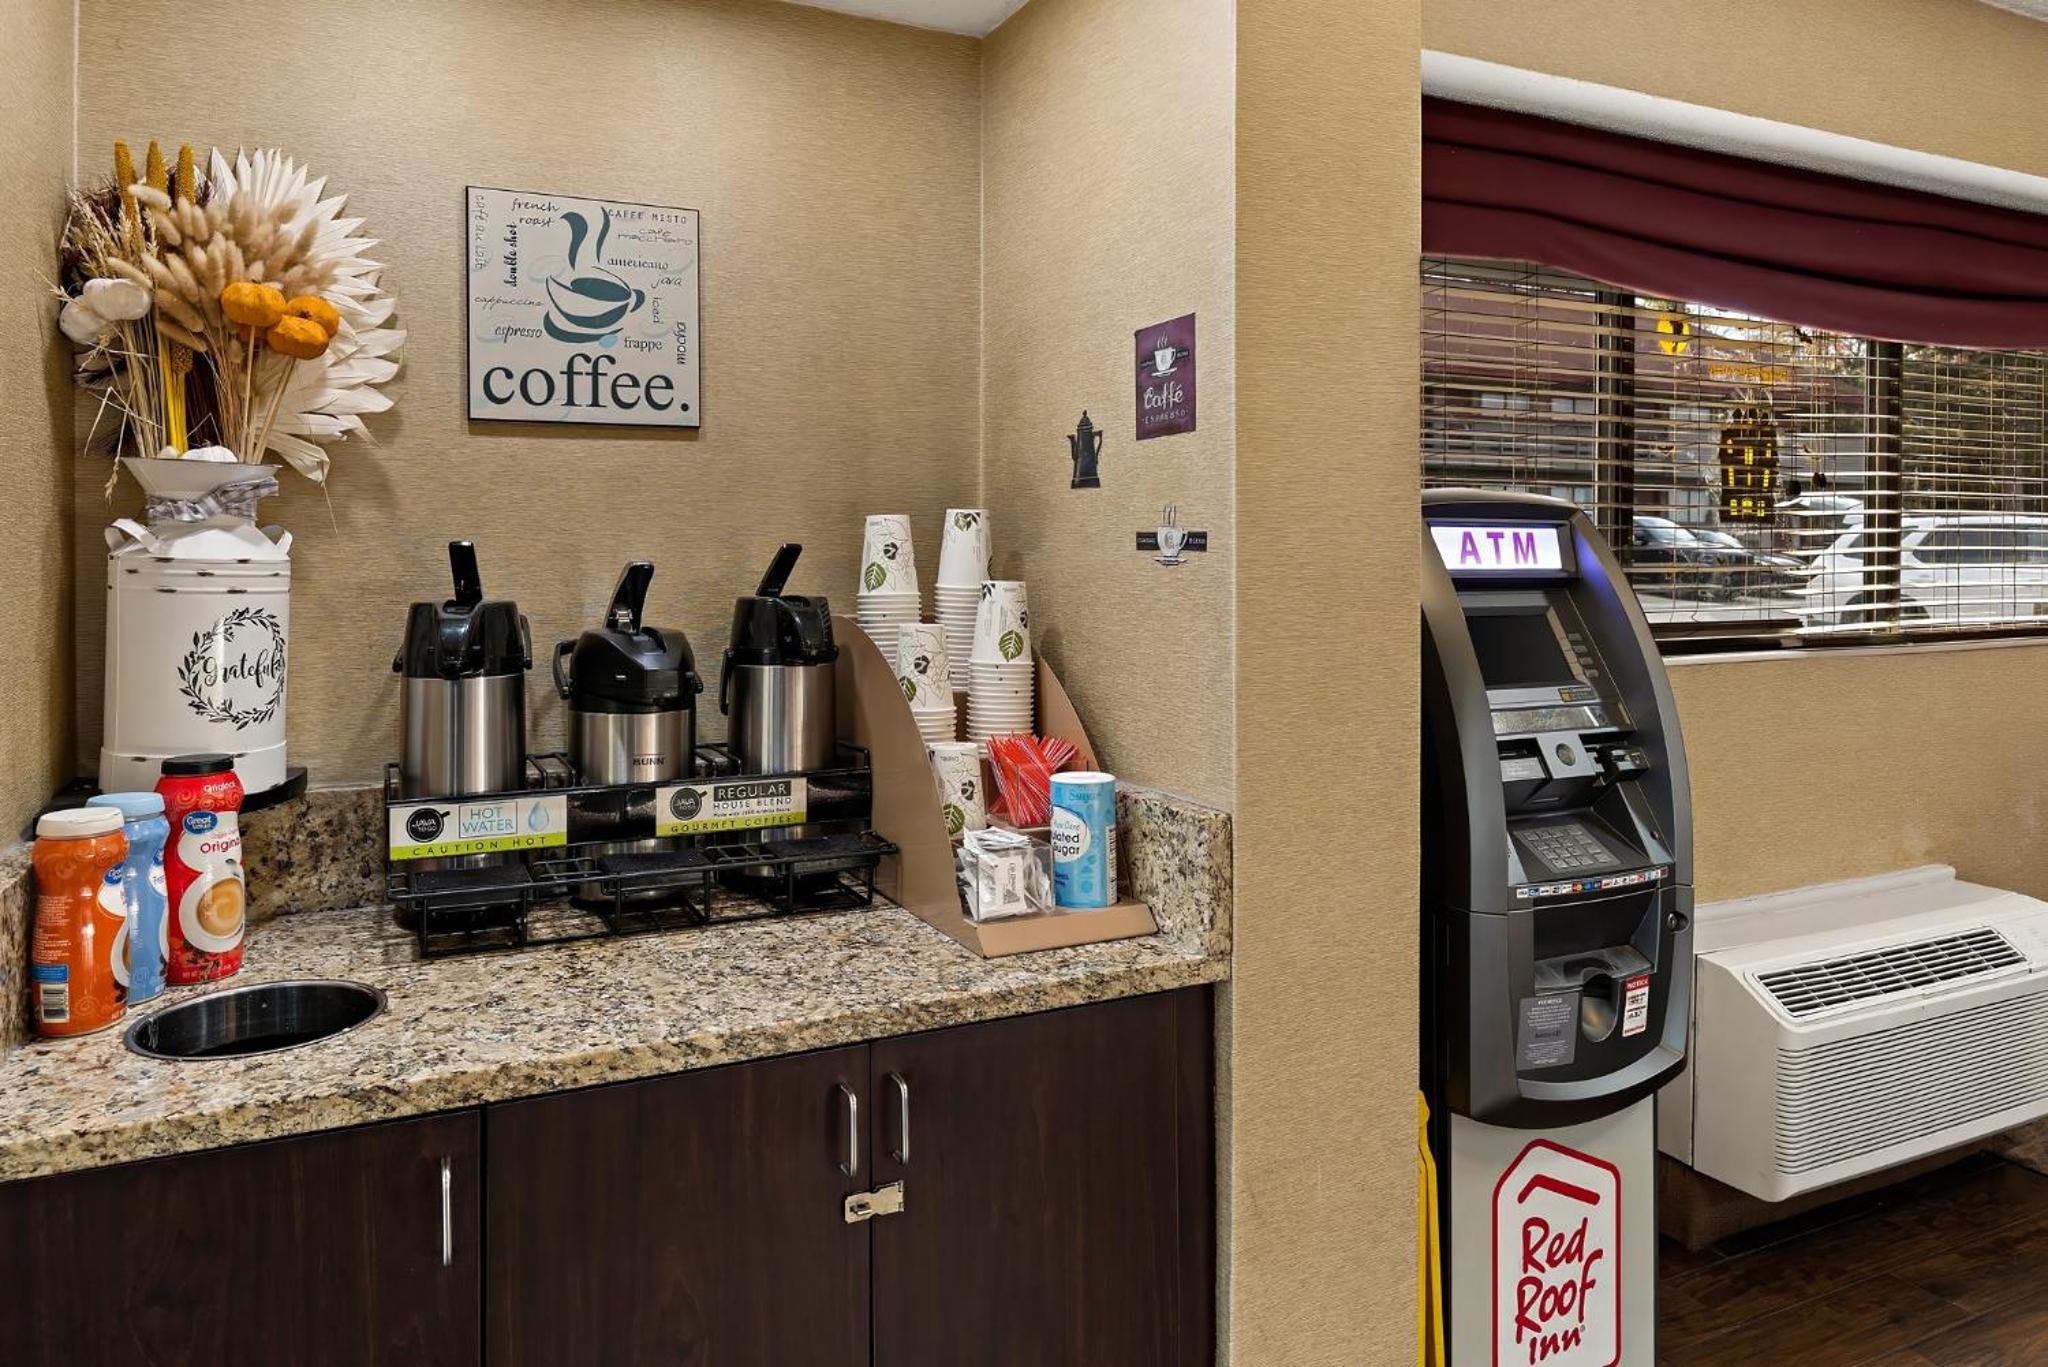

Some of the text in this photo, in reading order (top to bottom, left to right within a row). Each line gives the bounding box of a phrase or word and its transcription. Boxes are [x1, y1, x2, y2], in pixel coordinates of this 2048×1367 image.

[511, 198, 560, 213] french
[519, 216, 554, 228] roast
[652, 213, 687, 224] MISTO
[503, 224, 517, 287] double shot
[607, 255, 669, 270] americano
[651, 274, 683, 289] java
[474, 295, 545, 310] cappuccino
[494, 325, 543, 344] espresso
[623, 336, 664, 353] frappe
[673, 321, 687, 365] mocha
[483, 353, 690, 412] coffee.
[1460, 531, 1539, 565] ATM
[203, 648, 278, 688] Grateful
[633, 757, 665, 766] BUNN
[718, 784, 788, 800] REGULAR
[713, 797, 792, 810] HOUSE BLEND
[470, 806, 504, 820] HOT
[462, 818, 514, 833] WATER
[671, 816, 792, 833] GOURMET COFFEE
[413, 836, 547, 856] CAUTION HOT
[1522, 1216, 1588, 1274] Red
[1515, 1249, 1603, 1344] Roof
